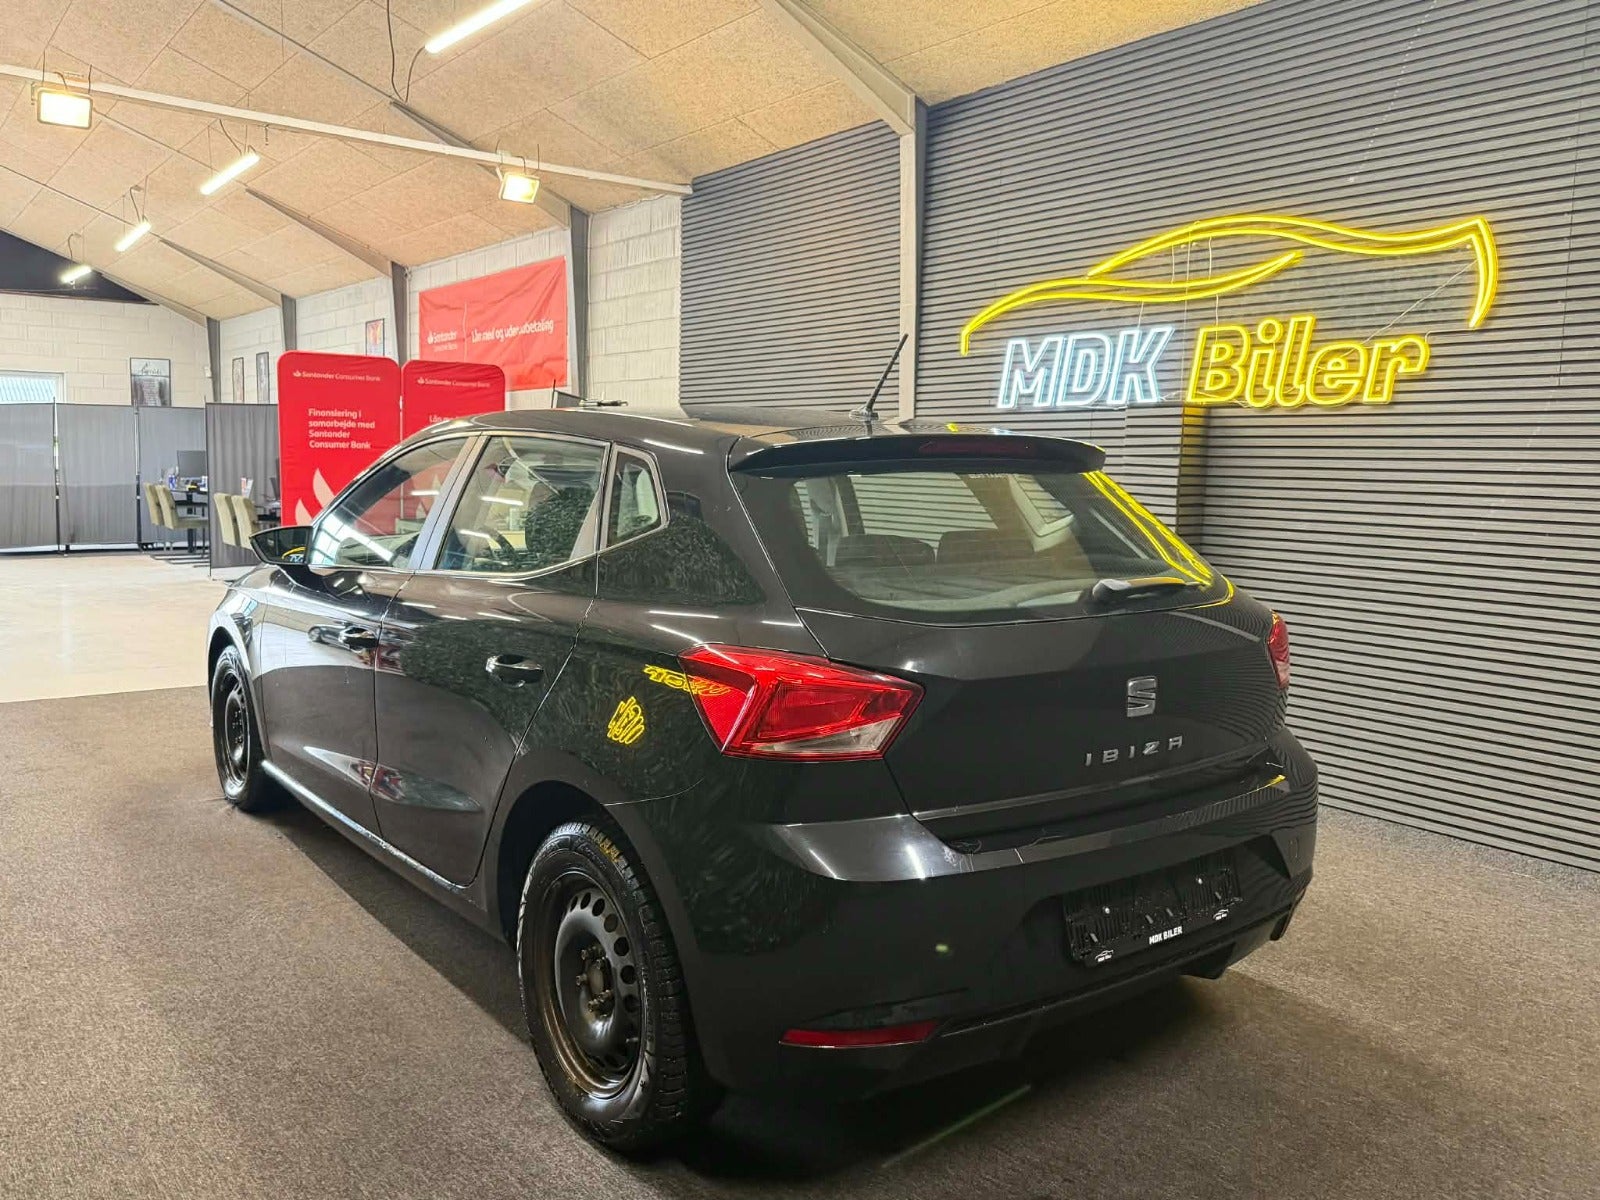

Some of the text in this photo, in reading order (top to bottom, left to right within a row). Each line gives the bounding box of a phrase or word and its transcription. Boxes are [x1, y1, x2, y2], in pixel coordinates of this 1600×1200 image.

[998, 315, 1431, 409] MDK Biler
[302, 371, 335, 380] Santander
[308, 408, 362, 420] Finansiering i
[308, 419, 376, 430] samarbejde med
[308, 429, 351, 439] Santander
[309, 439, 371, 450] Consumer Bank
[1085, 735, 1183, 767] IBIZA
[1149, 925, 1183, 945] MDK BILER
